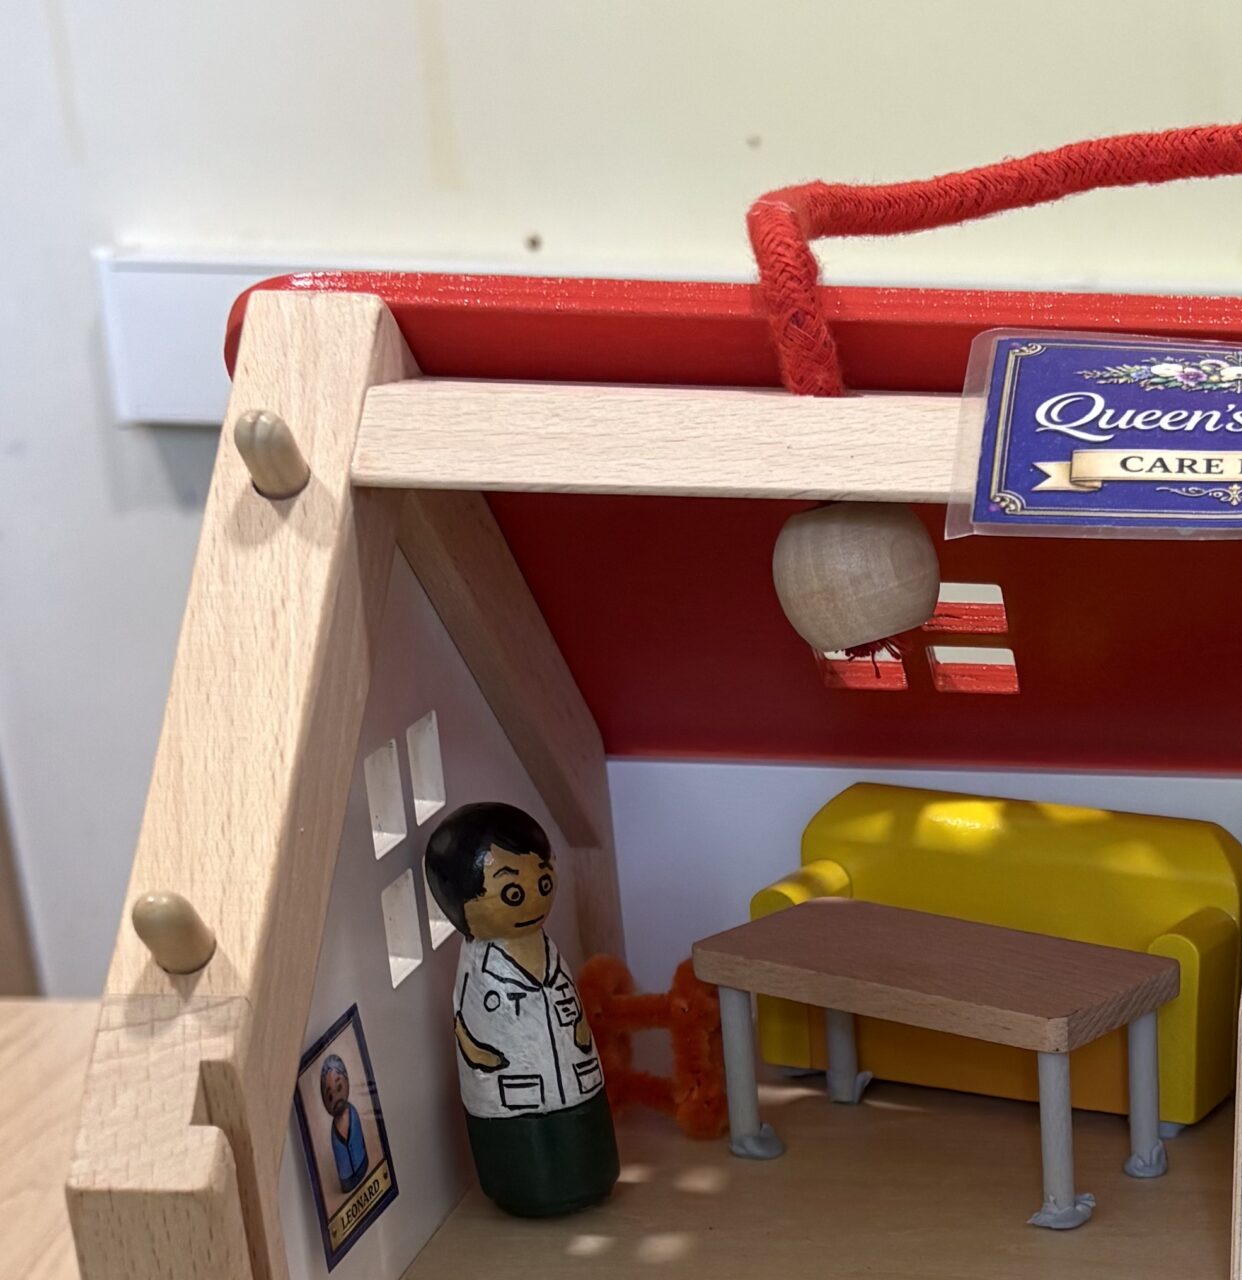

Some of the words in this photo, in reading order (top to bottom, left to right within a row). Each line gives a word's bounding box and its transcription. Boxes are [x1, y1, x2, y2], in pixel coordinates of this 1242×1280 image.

[1119, 455, 1224, 475] CARE
[483, 990, 528, 1017] OT
[340, 1178, 381, 1230] LEONARD
